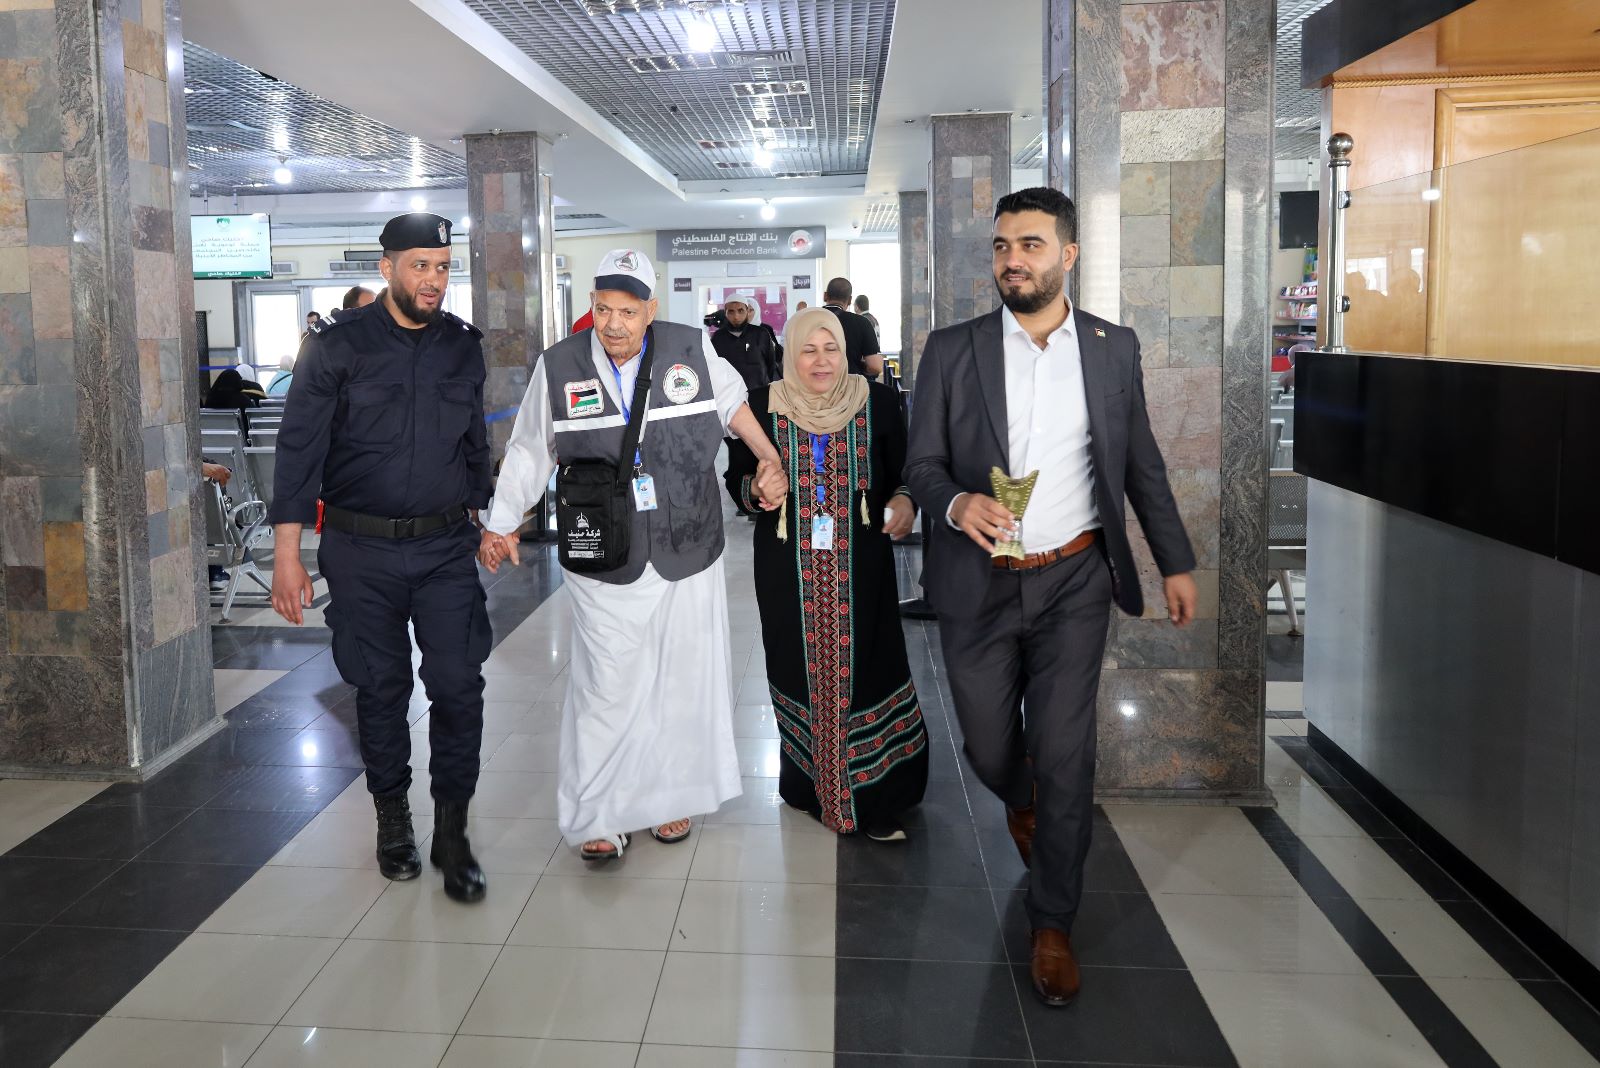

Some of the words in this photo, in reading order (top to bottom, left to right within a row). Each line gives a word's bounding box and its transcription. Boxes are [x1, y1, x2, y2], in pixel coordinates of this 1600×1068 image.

[671, 233, 726, 247] الفلسطيني
[728, 233, 757, 246] الإنتاج
[760, 233, 778, 244] بنك
[671, 248, 709, 257] Palestine
[711, 247, 754, 256] Production
[756, 246, 778, 255] Bank
[585, 528, 601, 539] شركة
